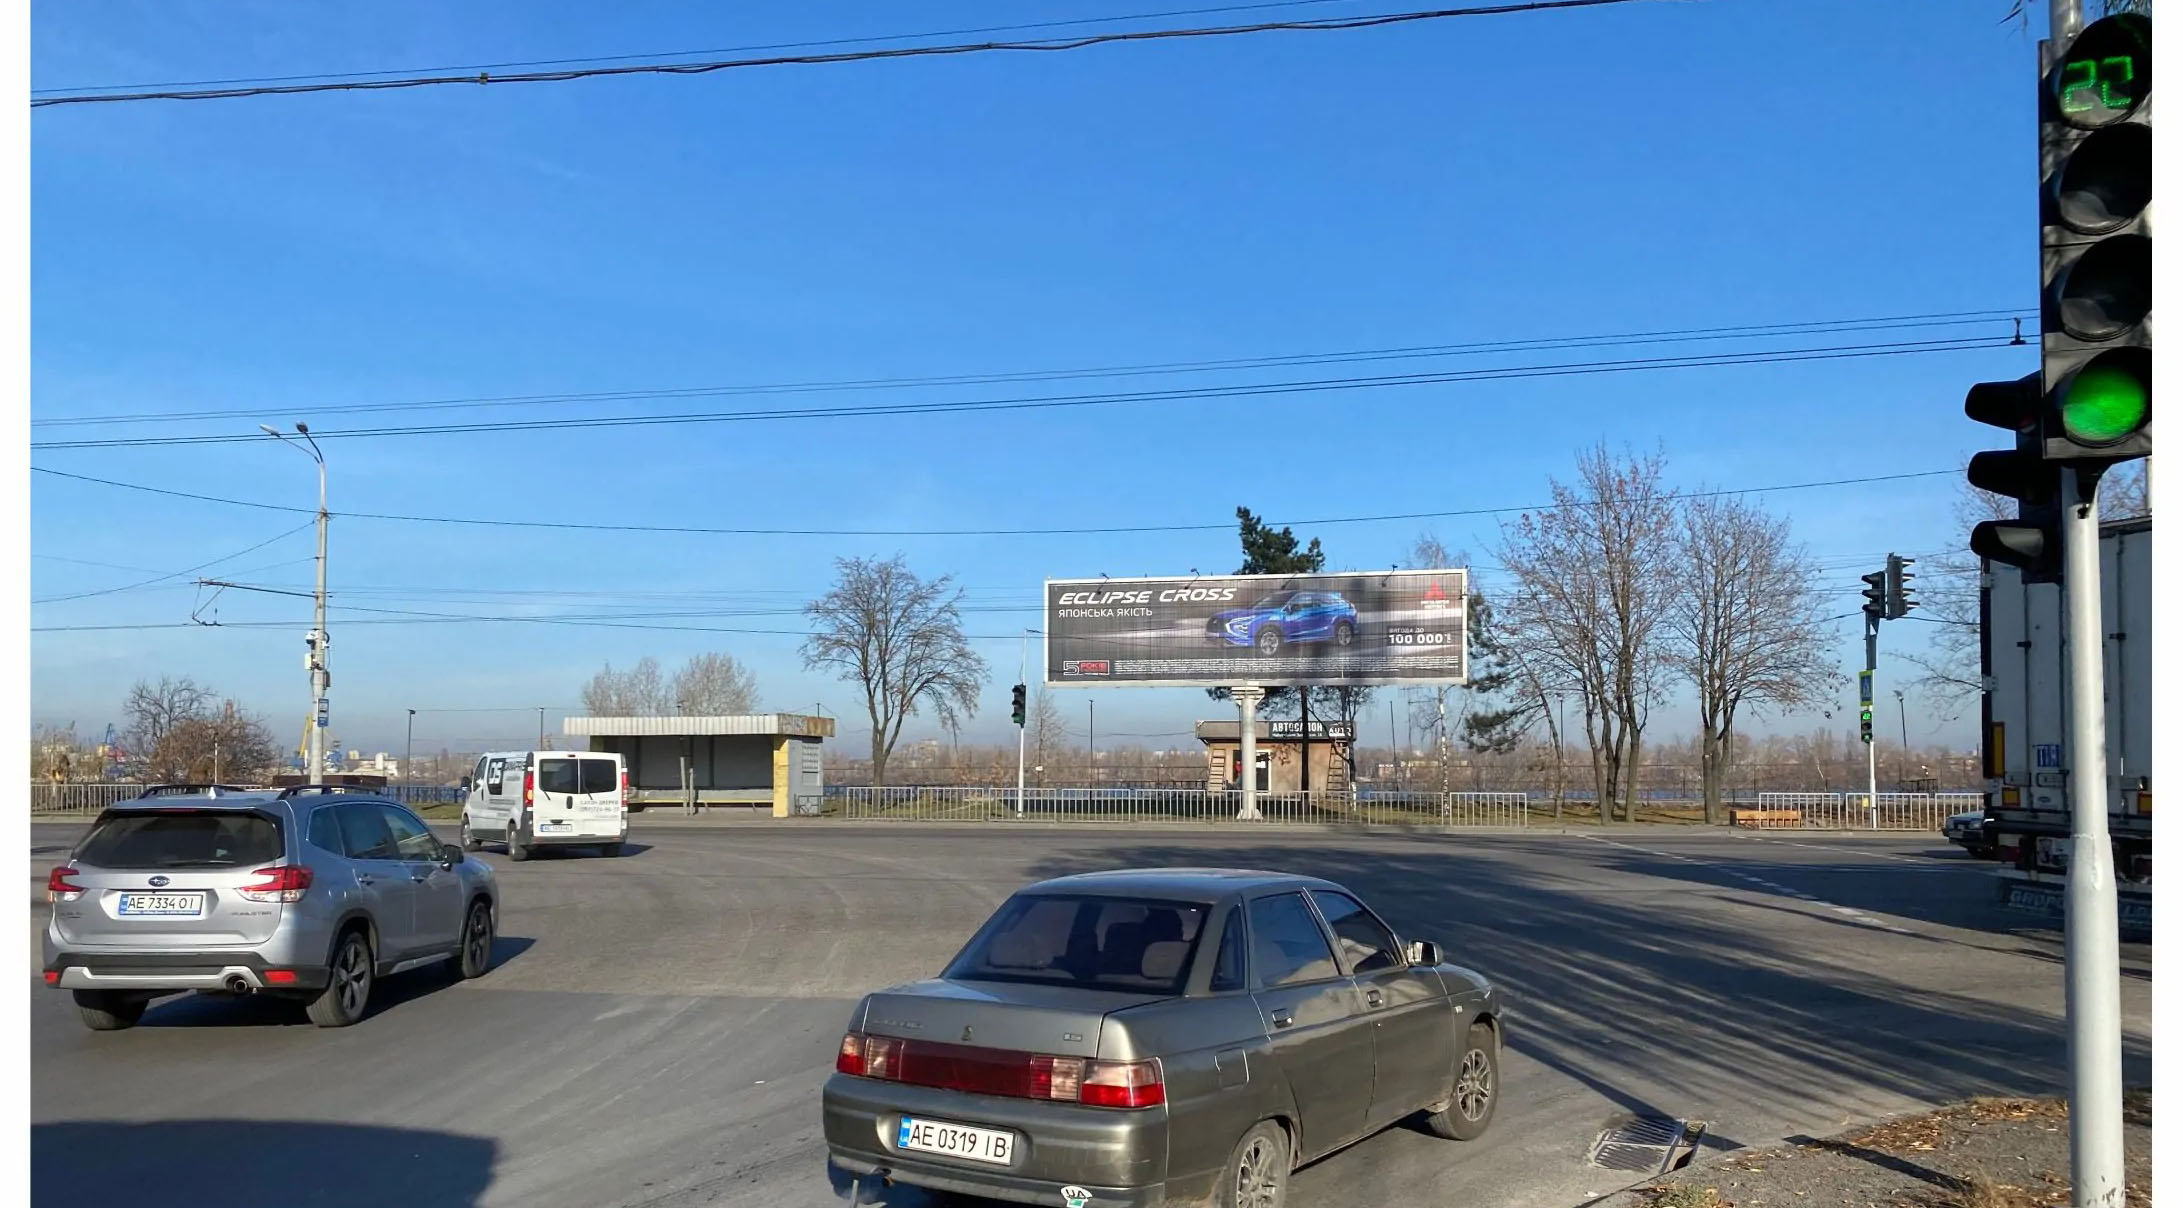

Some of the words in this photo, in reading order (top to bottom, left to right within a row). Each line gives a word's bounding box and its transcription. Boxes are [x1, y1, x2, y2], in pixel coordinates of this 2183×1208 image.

[1058, 590, 1153, 605] ECLIPSE
[1159, 587, 1238, 603] CROSS
[1058, 608, 1114, 618] ЯПОНСЬКА
[1116, 607, 1153, 617] ЯКІСТЬ
[1389, 634, 1413, 644] 100
[1417, 633, 1443, 644] 000
[1063, 660, 1080, 676] 5
[127, 897, 145, 909] AE
[148, 897, 176, 910] 7334
[910, 1124, 935, 1147] AE
[938, 1127, 978, 1154] 0319
[985, 1135, 1007, 1158] IB
